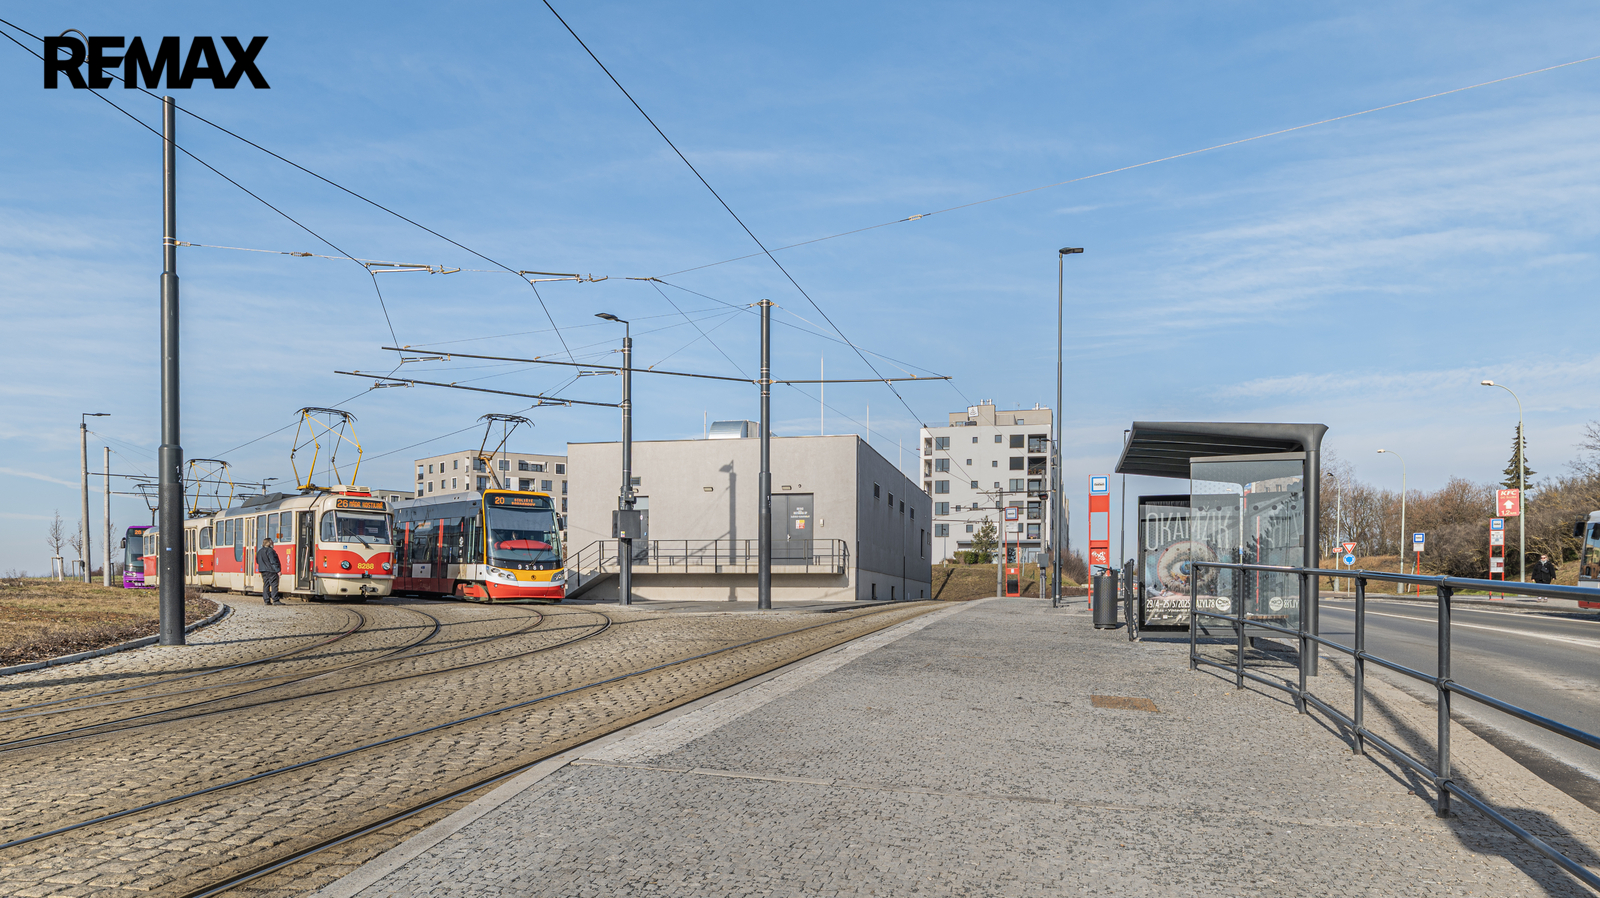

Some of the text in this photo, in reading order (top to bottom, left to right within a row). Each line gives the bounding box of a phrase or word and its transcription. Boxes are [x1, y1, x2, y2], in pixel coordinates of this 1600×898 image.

[337, 499, 349, 508] 26
[494, 496, 505, 505] 20
[1146, 505, 1230, 551] OKAMŽIK
[357, 562, 375, 570] 8288
